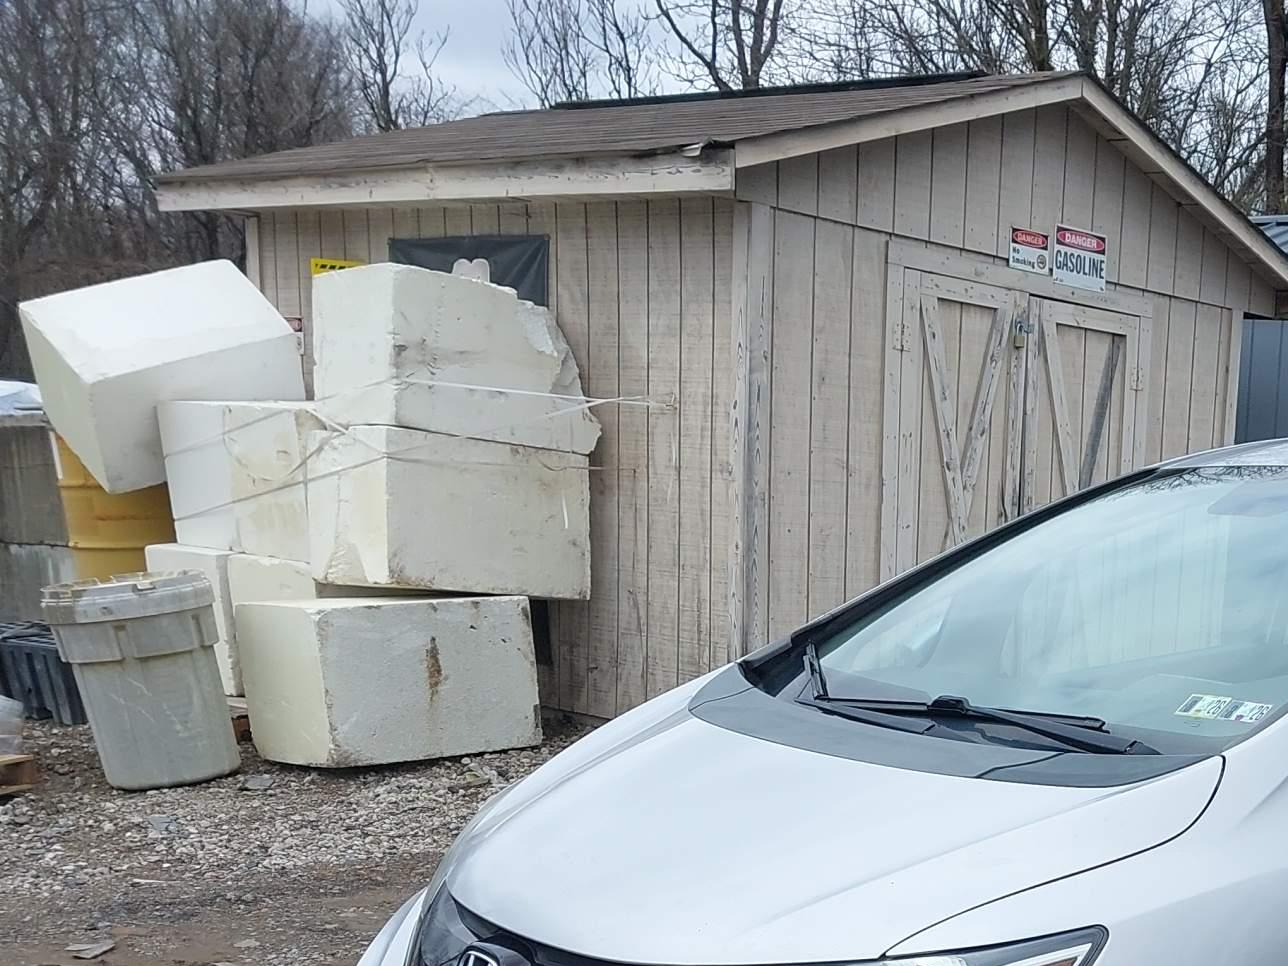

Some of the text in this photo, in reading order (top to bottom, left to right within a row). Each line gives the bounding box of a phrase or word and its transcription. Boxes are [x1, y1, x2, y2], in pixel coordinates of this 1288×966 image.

[1017, 232, 1043, 245] DANGER
[1065, 233, 1098, 249] DANGER
[1012, 246, 1020, 254] No
[1012, 256, 1035, 269] Smoking
[1055, 249, 1105, 279] GASOLINE
